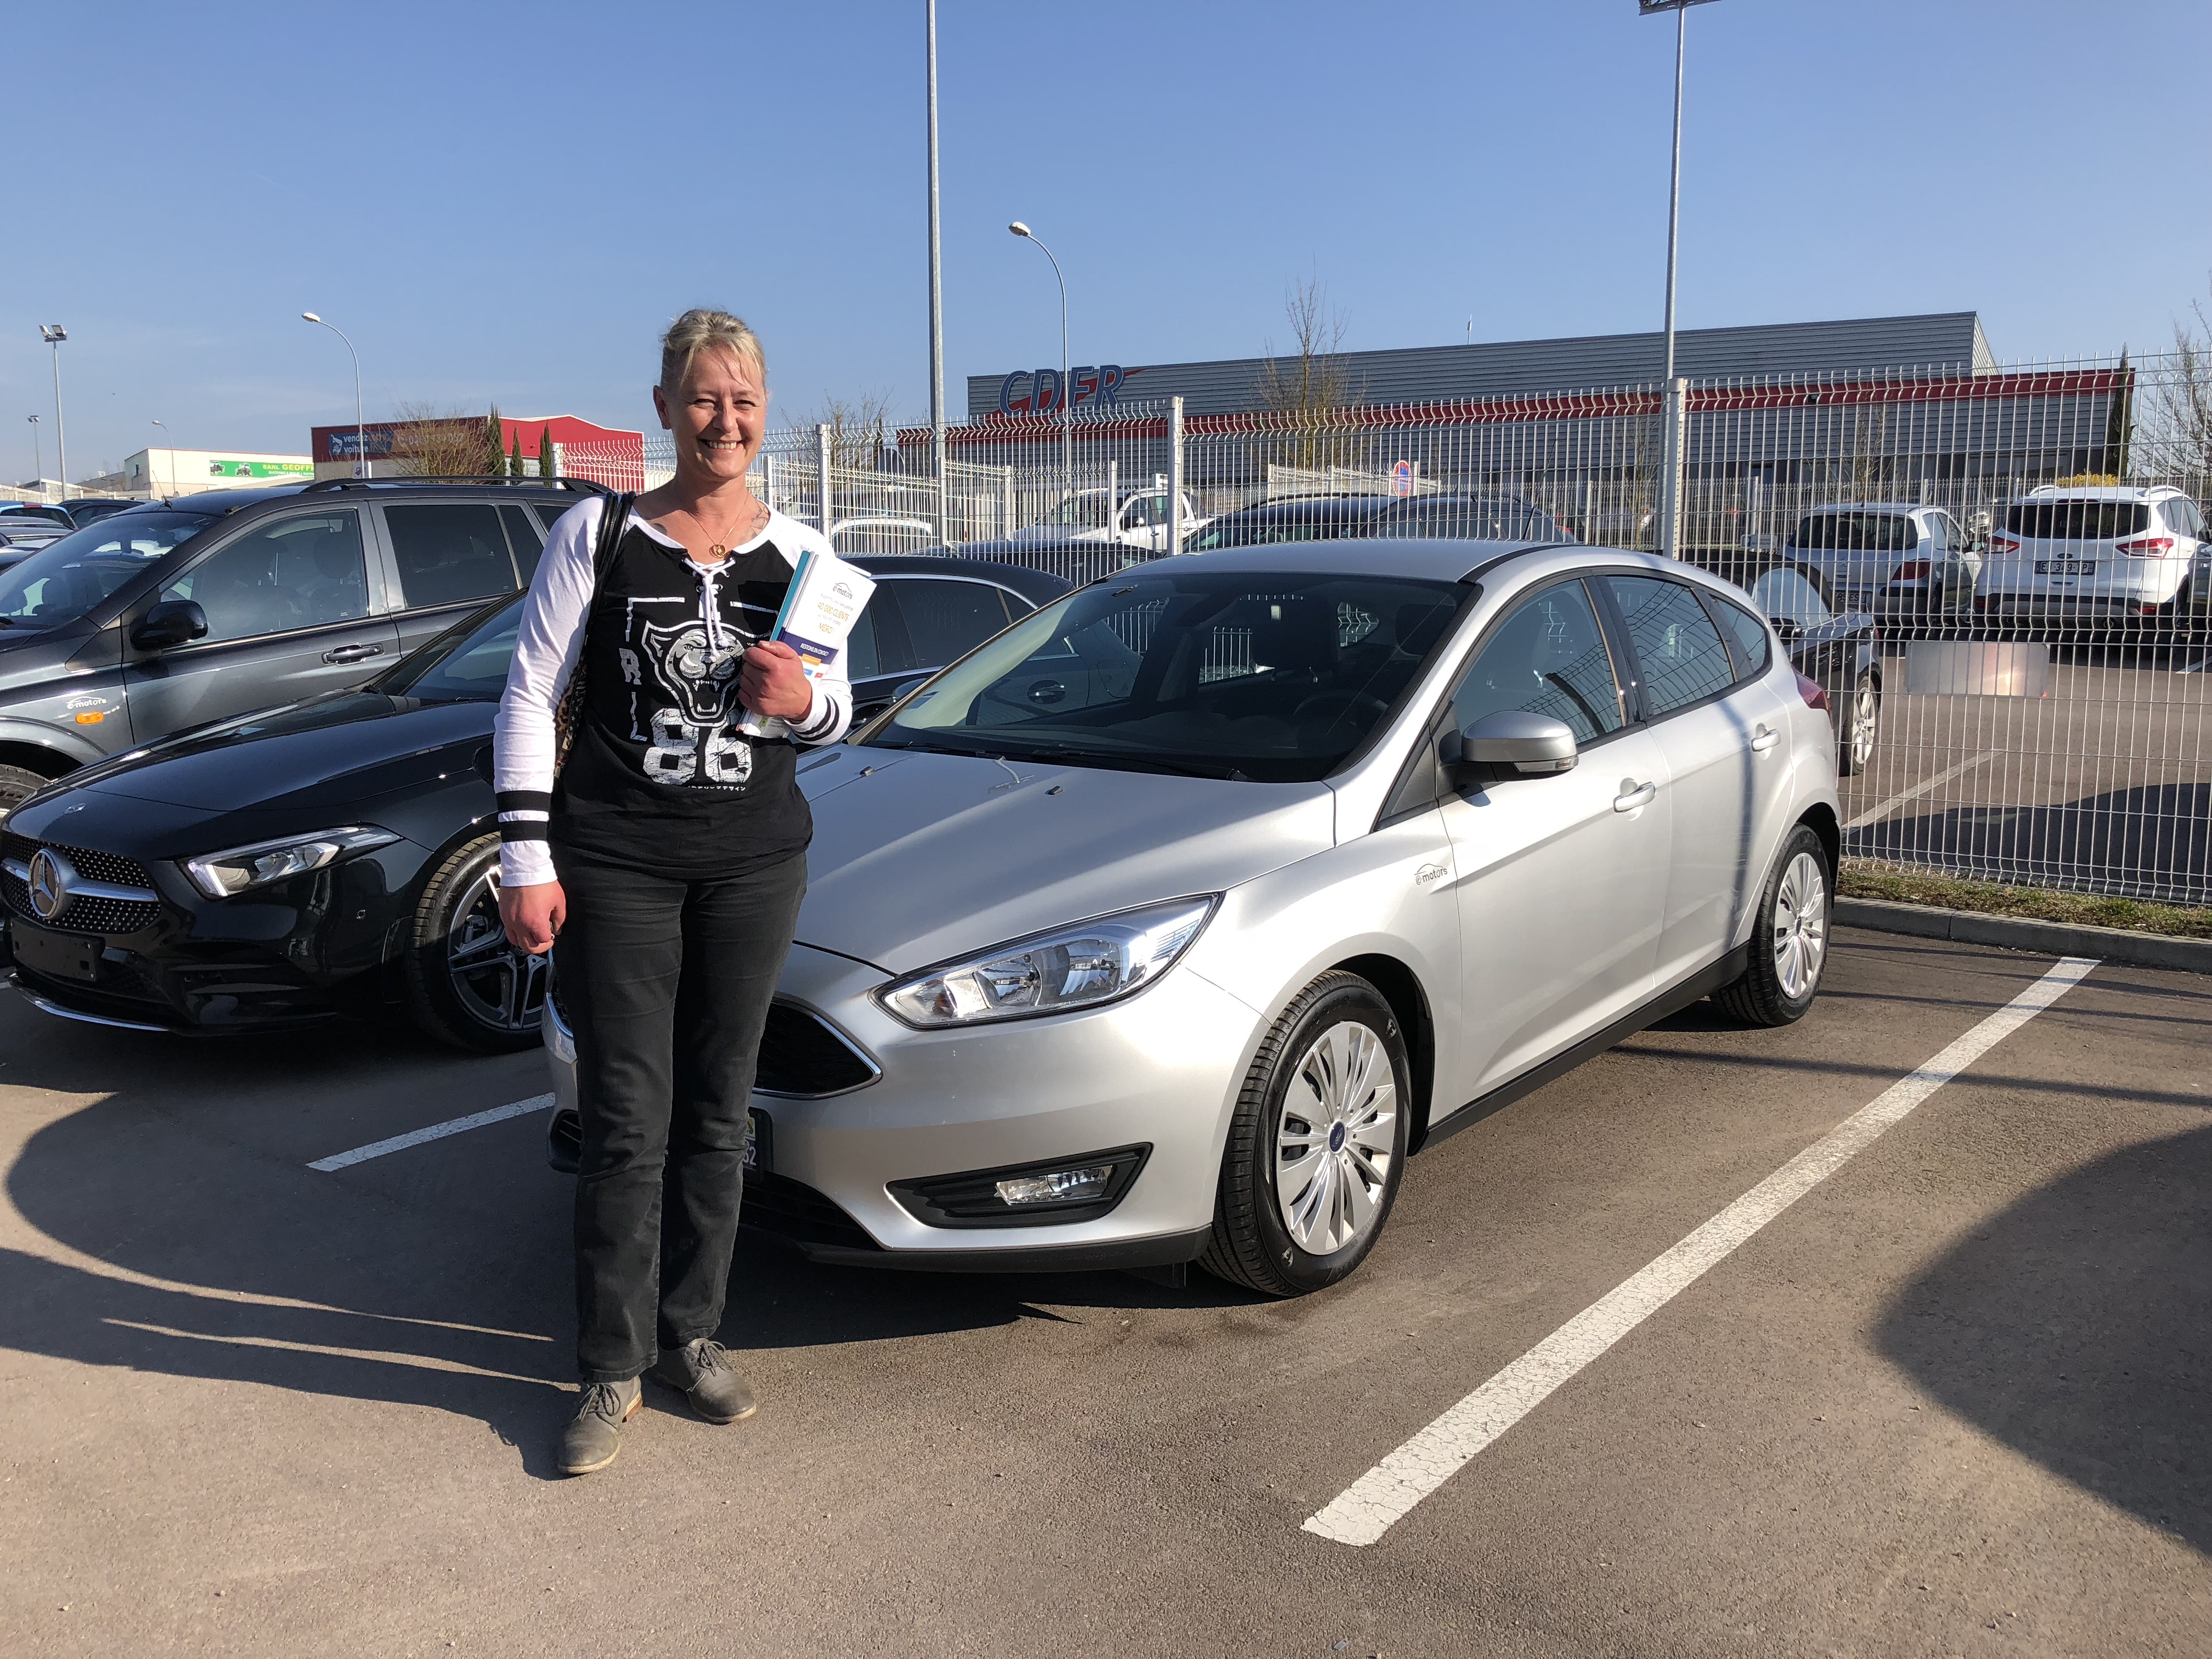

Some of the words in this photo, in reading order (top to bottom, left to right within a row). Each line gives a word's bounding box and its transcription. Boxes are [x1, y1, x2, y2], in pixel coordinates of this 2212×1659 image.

[999, 364, 1124, 417] CDER
[343, 432, 368, 442] vendz
[824, 605, 833, 614] 000
